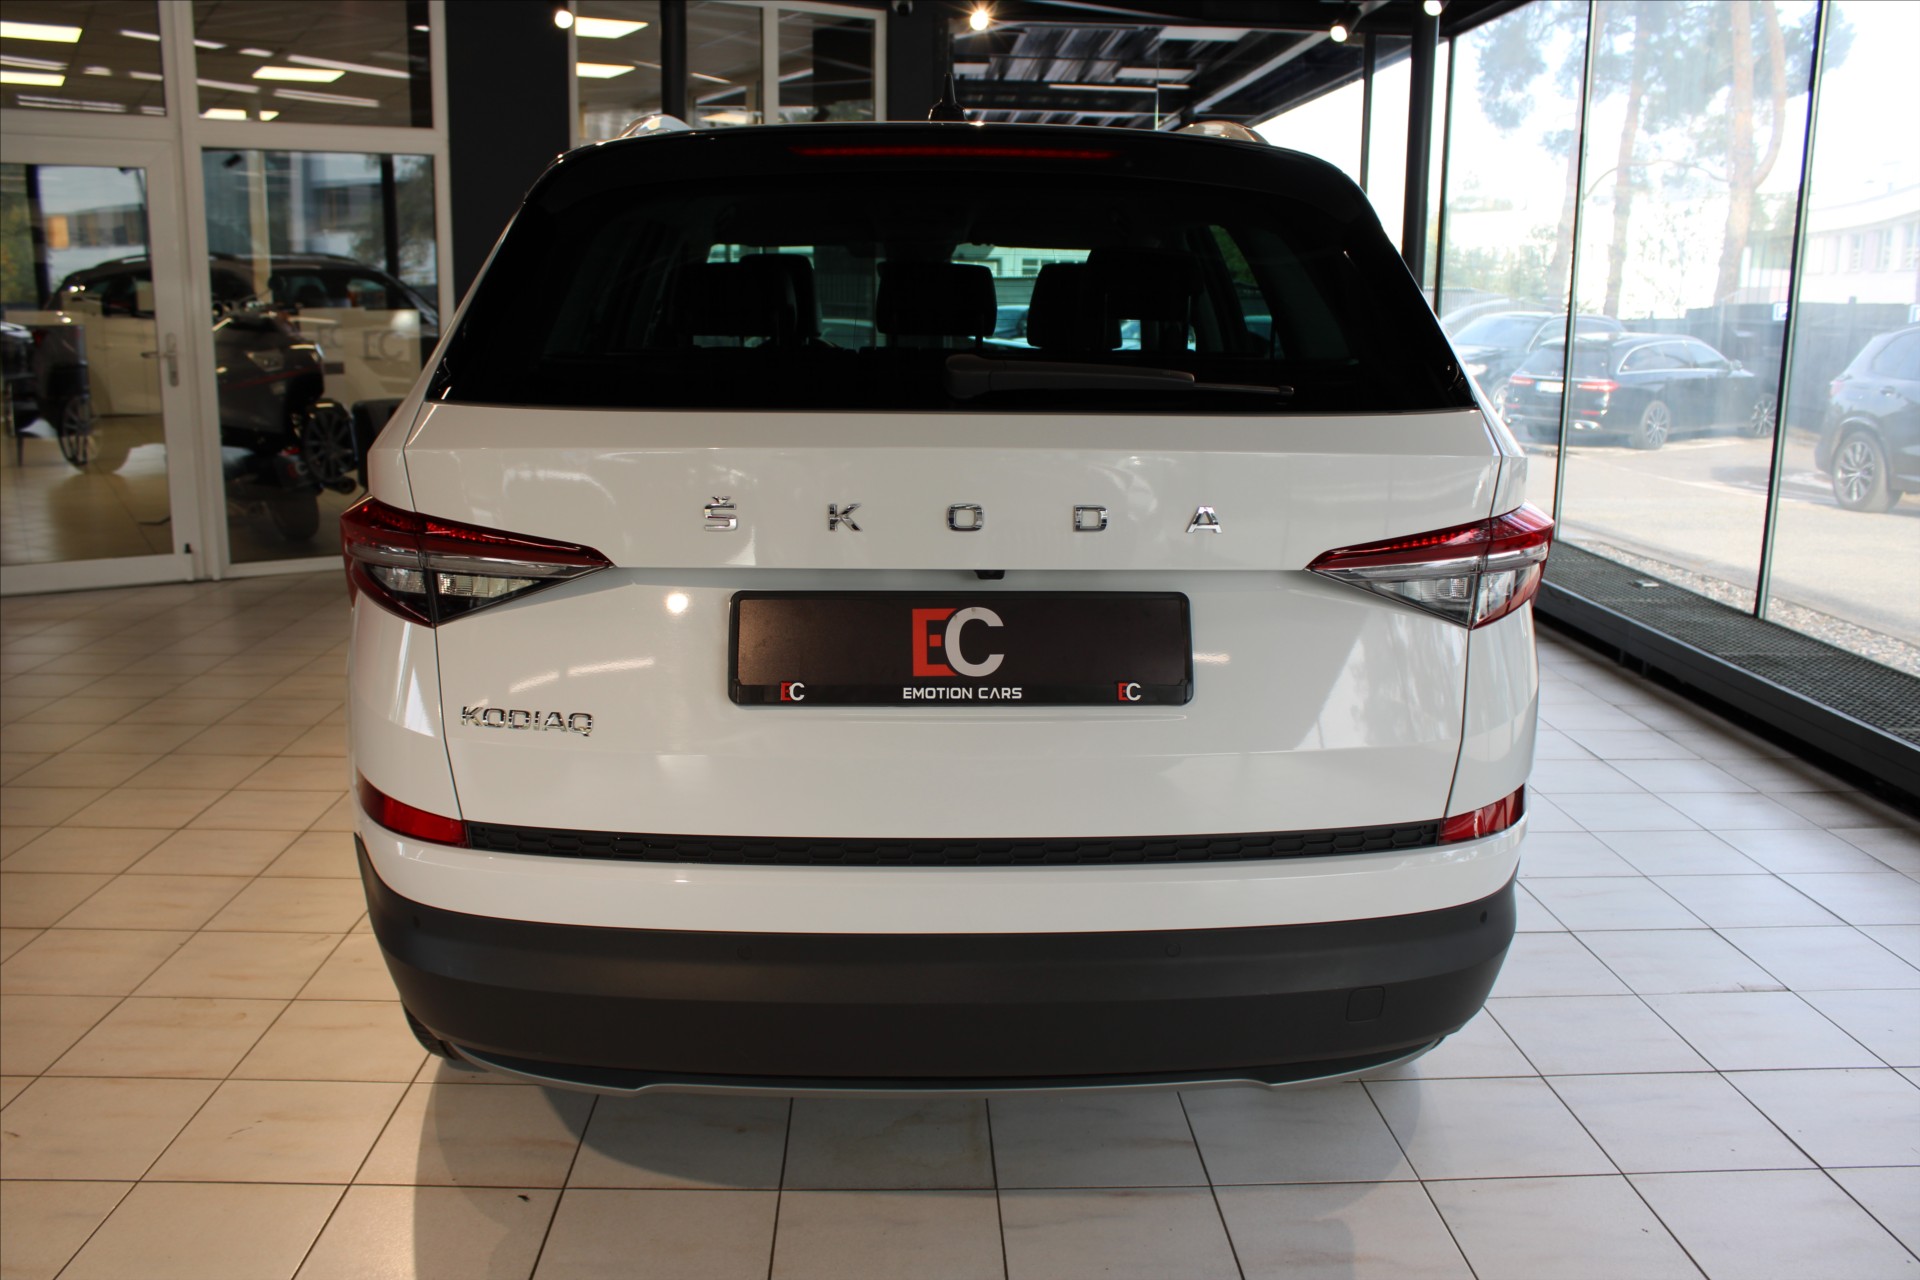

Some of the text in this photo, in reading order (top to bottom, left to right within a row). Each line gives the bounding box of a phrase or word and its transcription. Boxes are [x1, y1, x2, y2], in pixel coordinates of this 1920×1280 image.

[704, 496, 1223, 534] ŠKODA
[912, 606, 1005, 677] EC
[780, 682, 805, 701] EC
[902, 687, 1023, 700] EMOTION CARS
[1118, 682, 1142, 701] EC
[460, 705, 594, 737] KODIAQ
